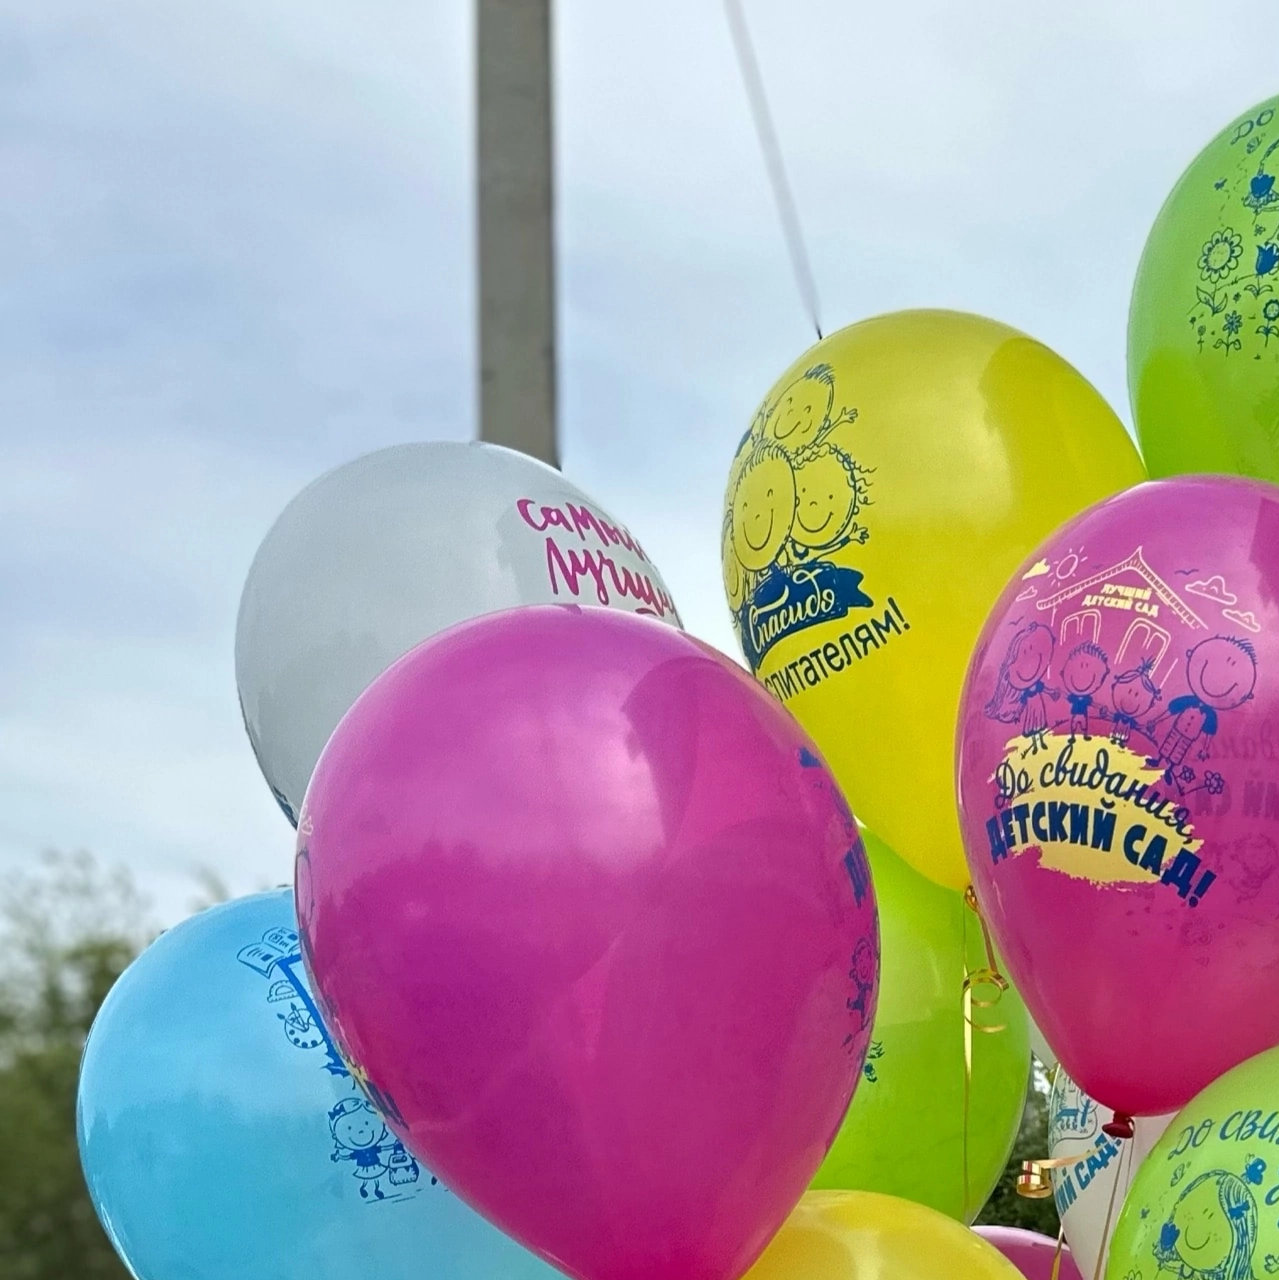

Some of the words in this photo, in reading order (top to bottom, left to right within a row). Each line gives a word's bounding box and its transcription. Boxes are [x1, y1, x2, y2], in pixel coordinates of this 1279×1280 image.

[1231, 108, 1274, 145] ДО
[749, 568, 835, 654] Спасибо
[1081, 595, 1133, 610] ДЕТСКИЙ
[1134, 602, 1159, 617] САД
[1101, 583, 1152, 600] ЛУЧШИЙ
[764, 597, 911, 703] спитателям!
[995, 758, 1034, 809] До
[986, 797, 1117, 866] ДЕТСКИЙ
[1123, 824, 1216, 908] САД!
[1167, 1119, 1216, 1161] ДО
